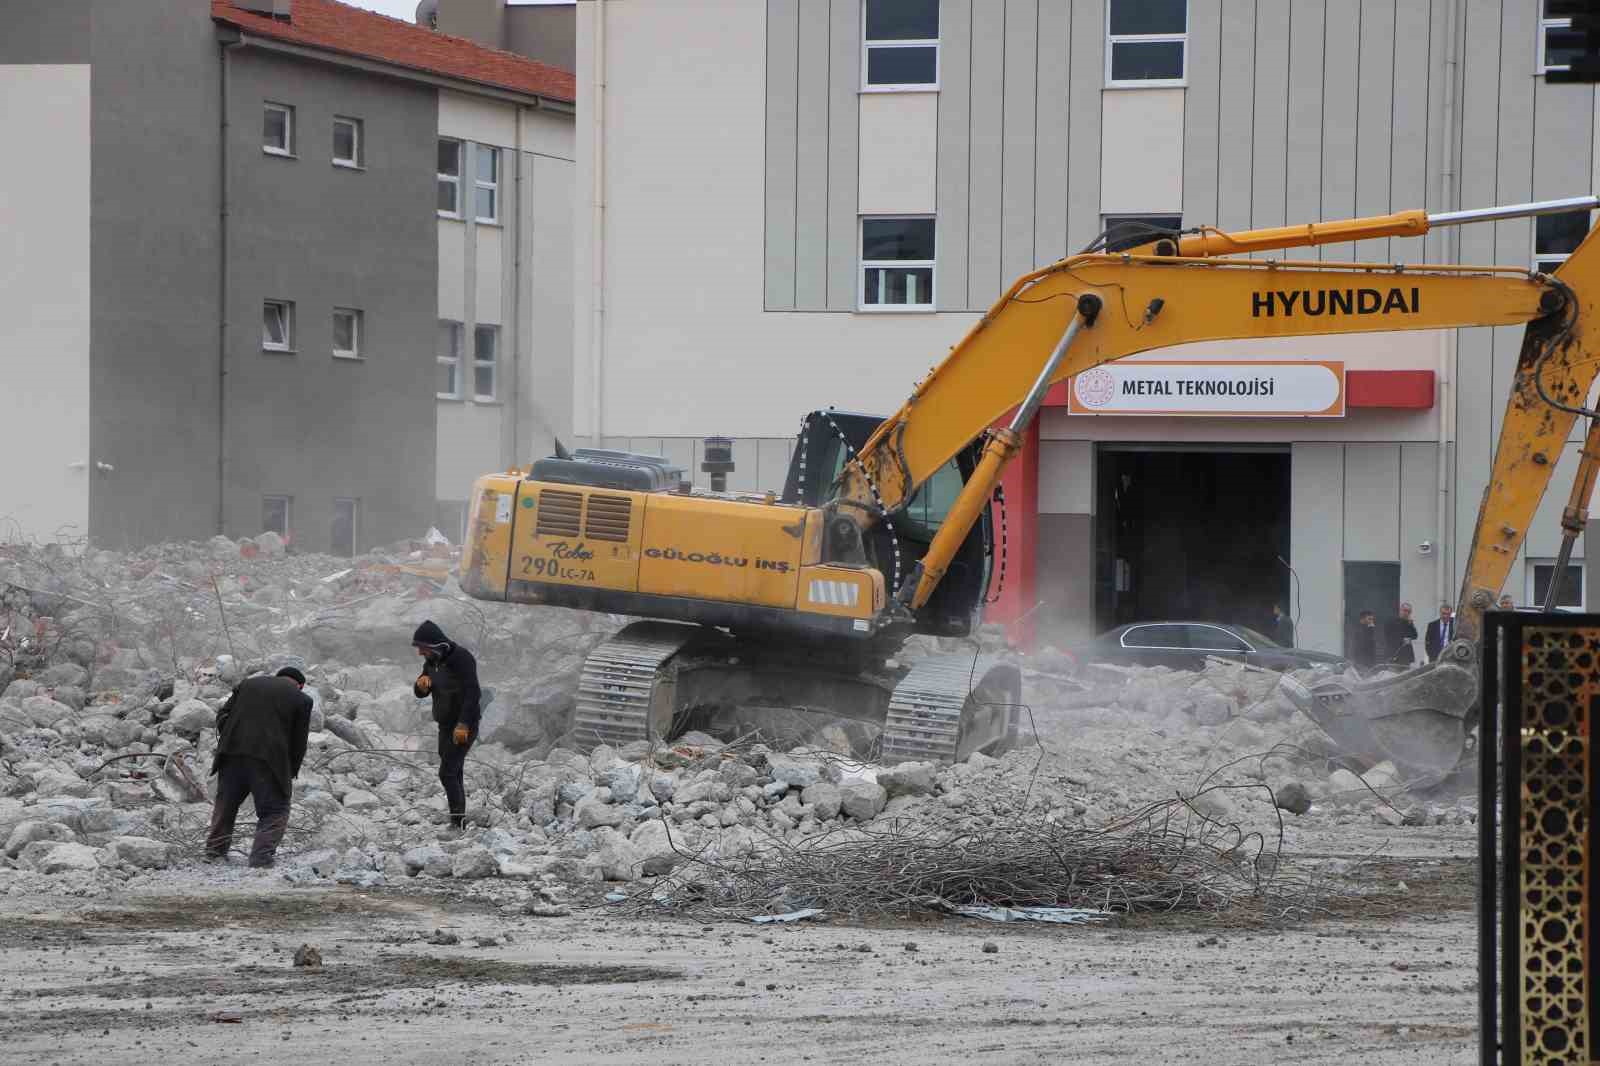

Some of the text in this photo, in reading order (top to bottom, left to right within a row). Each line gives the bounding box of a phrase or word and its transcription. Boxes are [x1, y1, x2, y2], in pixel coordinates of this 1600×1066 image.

[1252, 288, 1419, 317] HYUNDAI
[1122, 380, 1172, 395] METAL
[1176, 377, 1274, 396] TEKNOLOJİSİ
[644, 547, 749, 567] GÜLOĞLU
